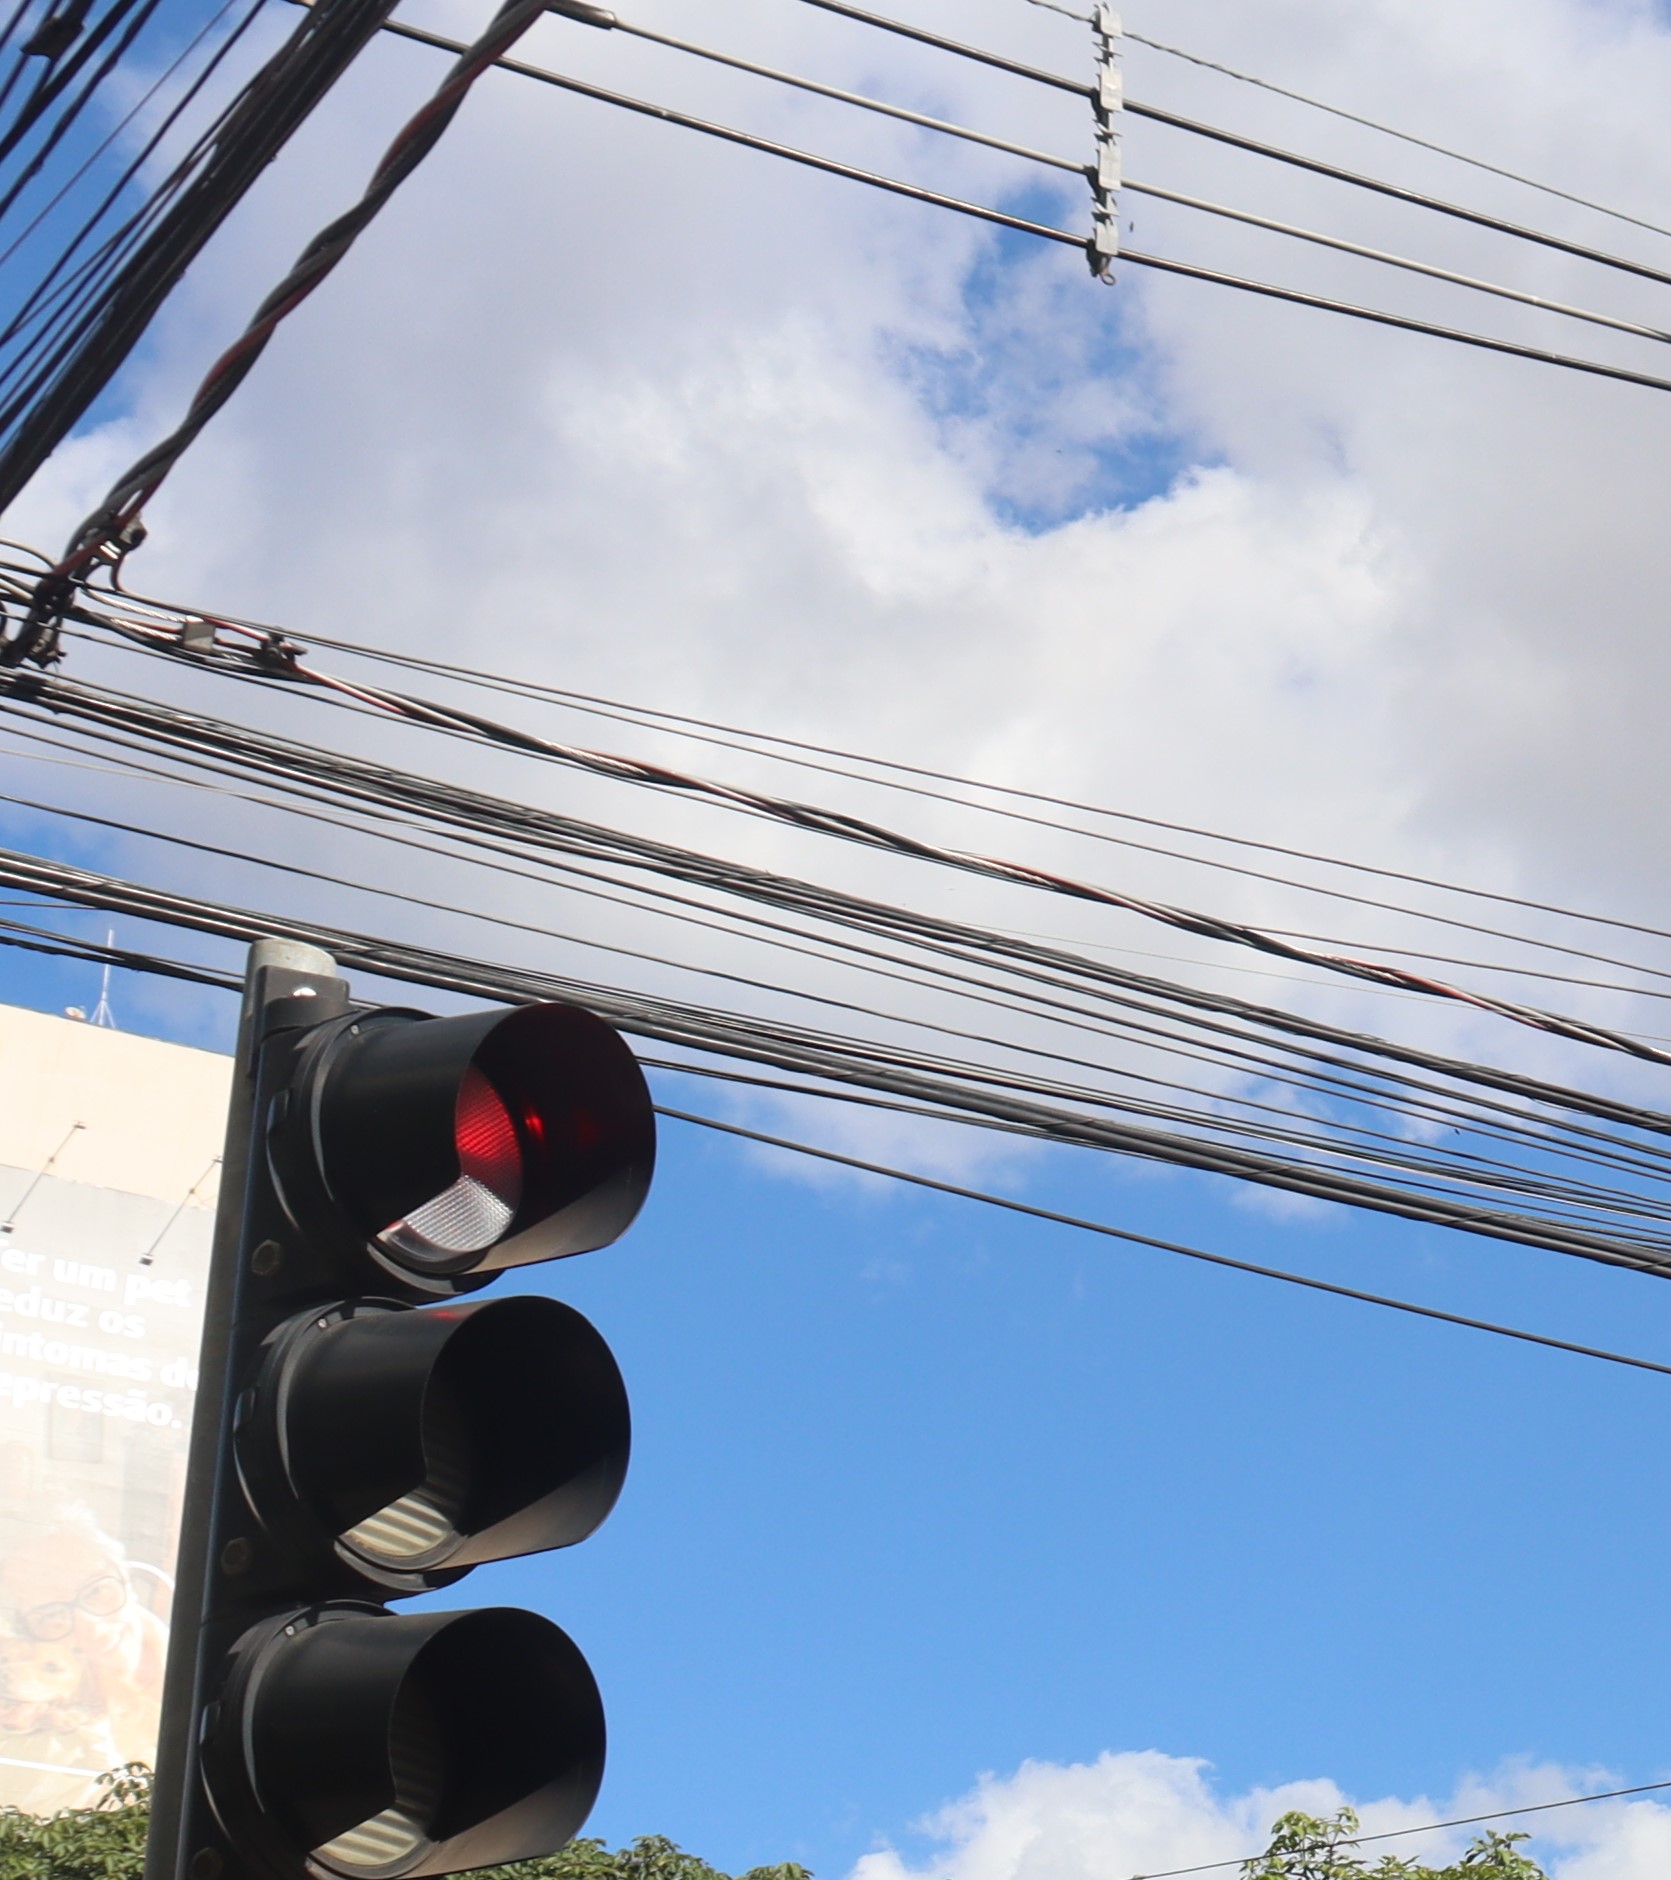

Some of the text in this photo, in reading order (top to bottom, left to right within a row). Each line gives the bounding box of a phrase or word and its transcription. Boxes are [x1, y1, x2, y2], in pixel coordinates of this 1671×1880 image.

[0, 1238, 193, 1308] er um pet
[0, 1286, 146, 1339] eduz os
